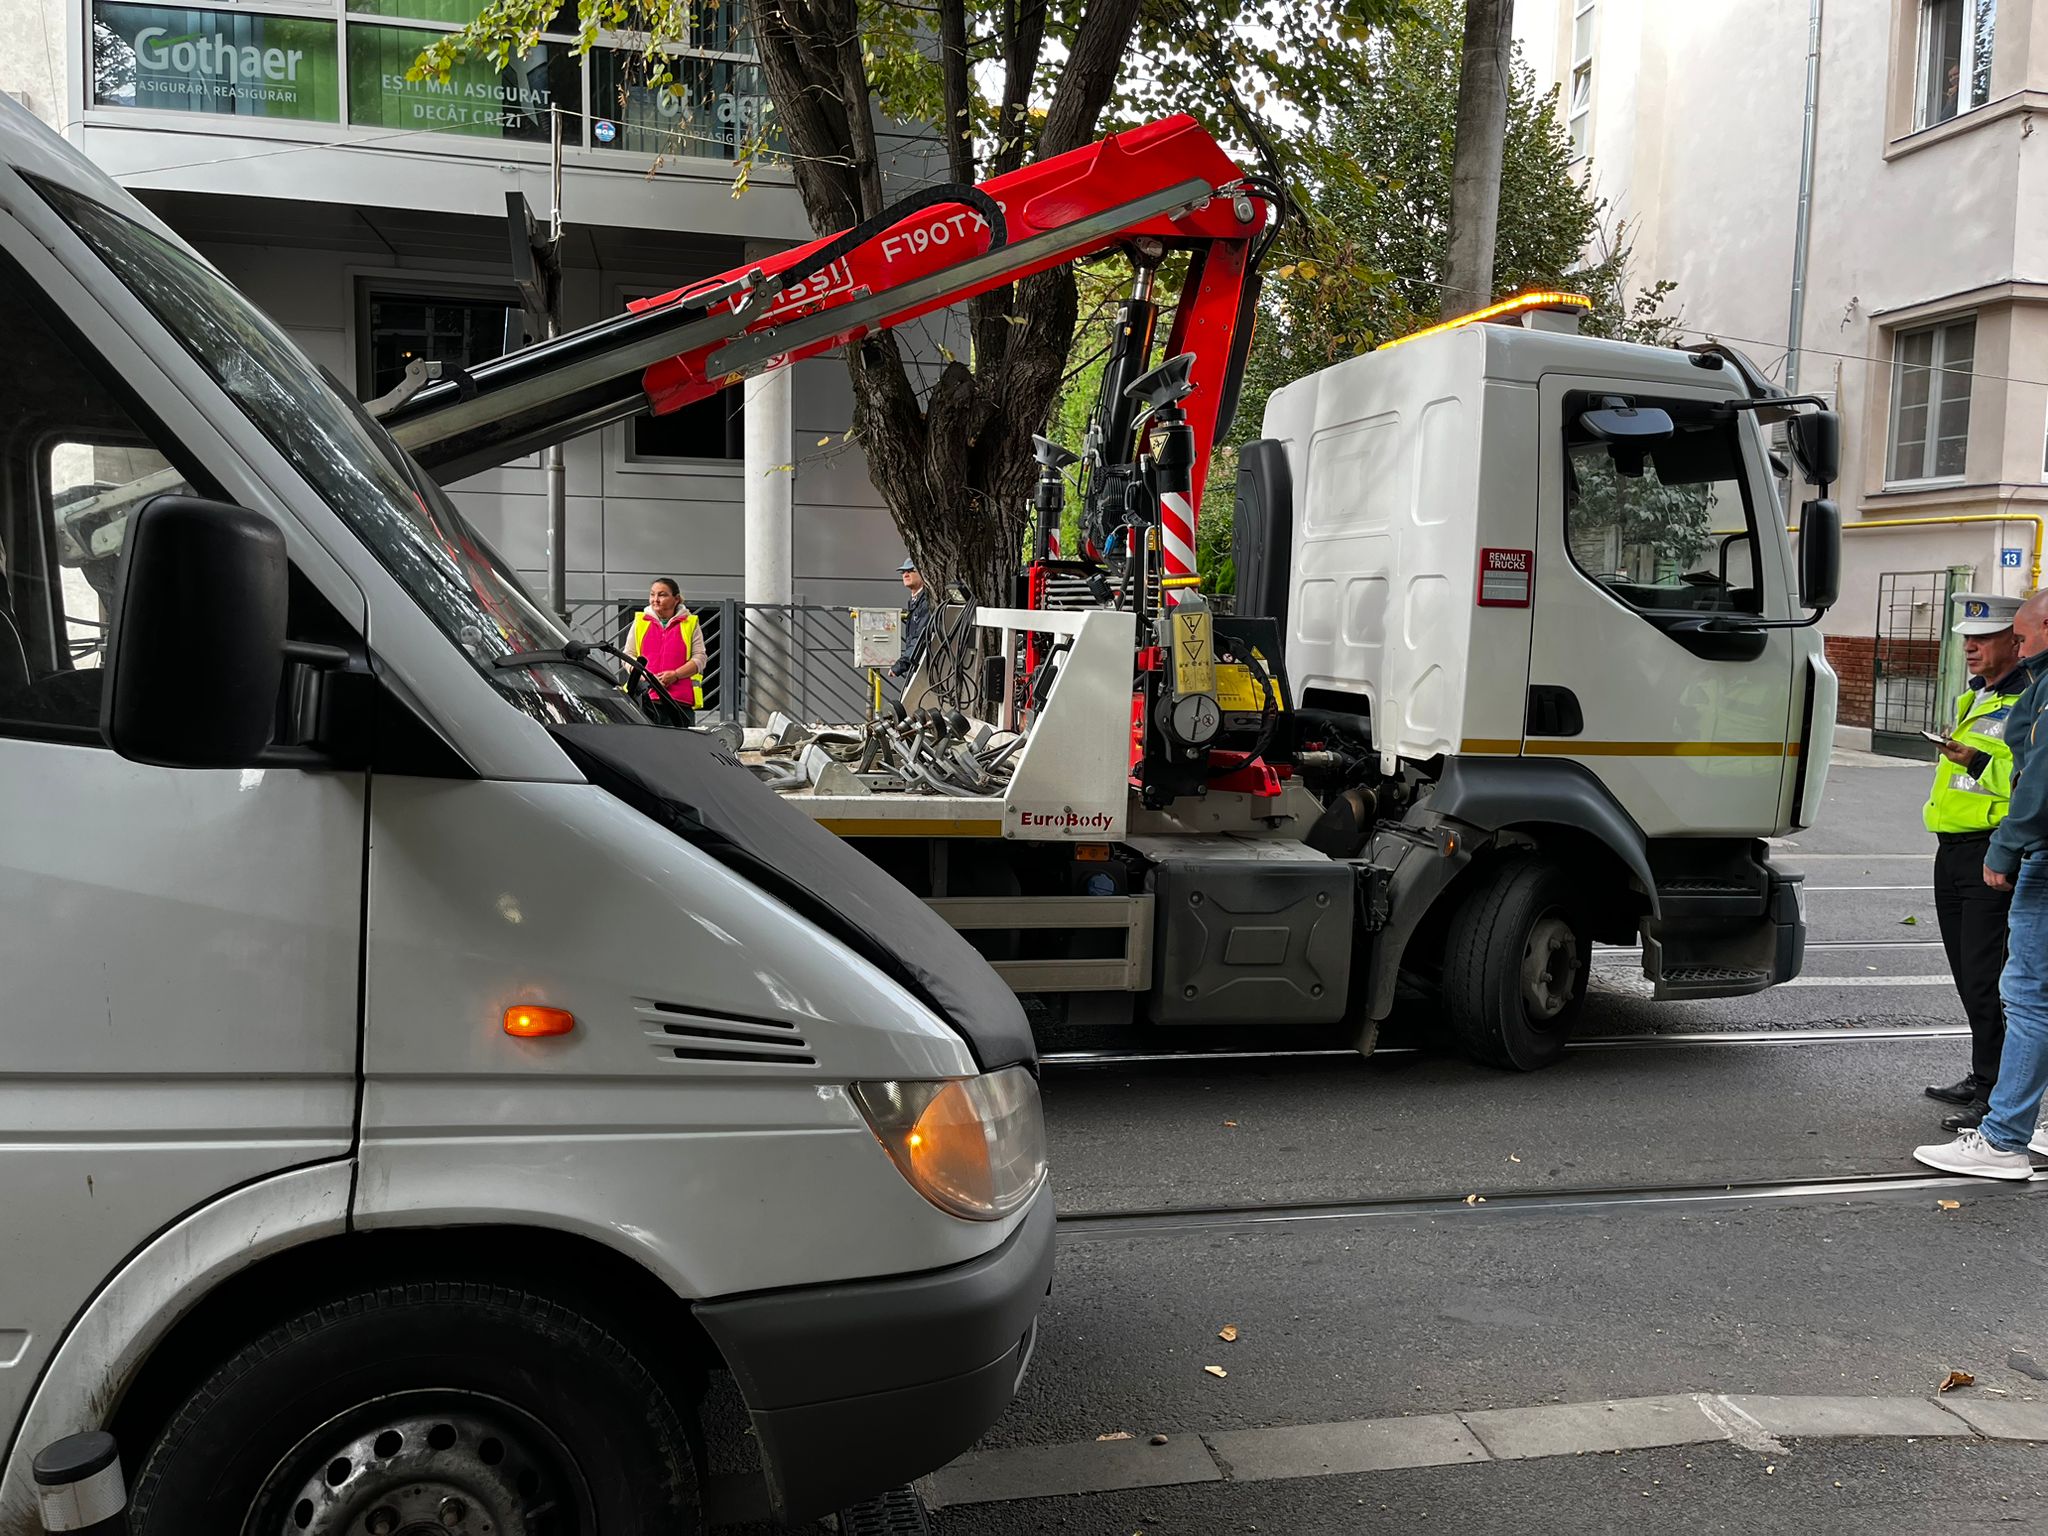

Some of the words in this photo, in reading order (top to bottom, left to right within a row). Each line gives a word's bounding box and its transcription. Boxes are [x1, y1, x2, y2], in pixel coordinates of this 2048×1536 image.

[134, 27, 303, 84] Gothaer
[213, 86, 297, 103] REASIGURĂRI
[426, 79, 458, 96] MAI
[464, 82, 551, 105] ASIGURAT
[413, 104, 467, 122] DECÂT
[473, 109, 521, 128] CREZI
[1489, 552, 1526, 562] RENAULT
[1489, 560, 1526, 570] TRUCKS
[2004, 553, 2017, 566] 13
[1021, 812, 1113, 832] EuroBody
